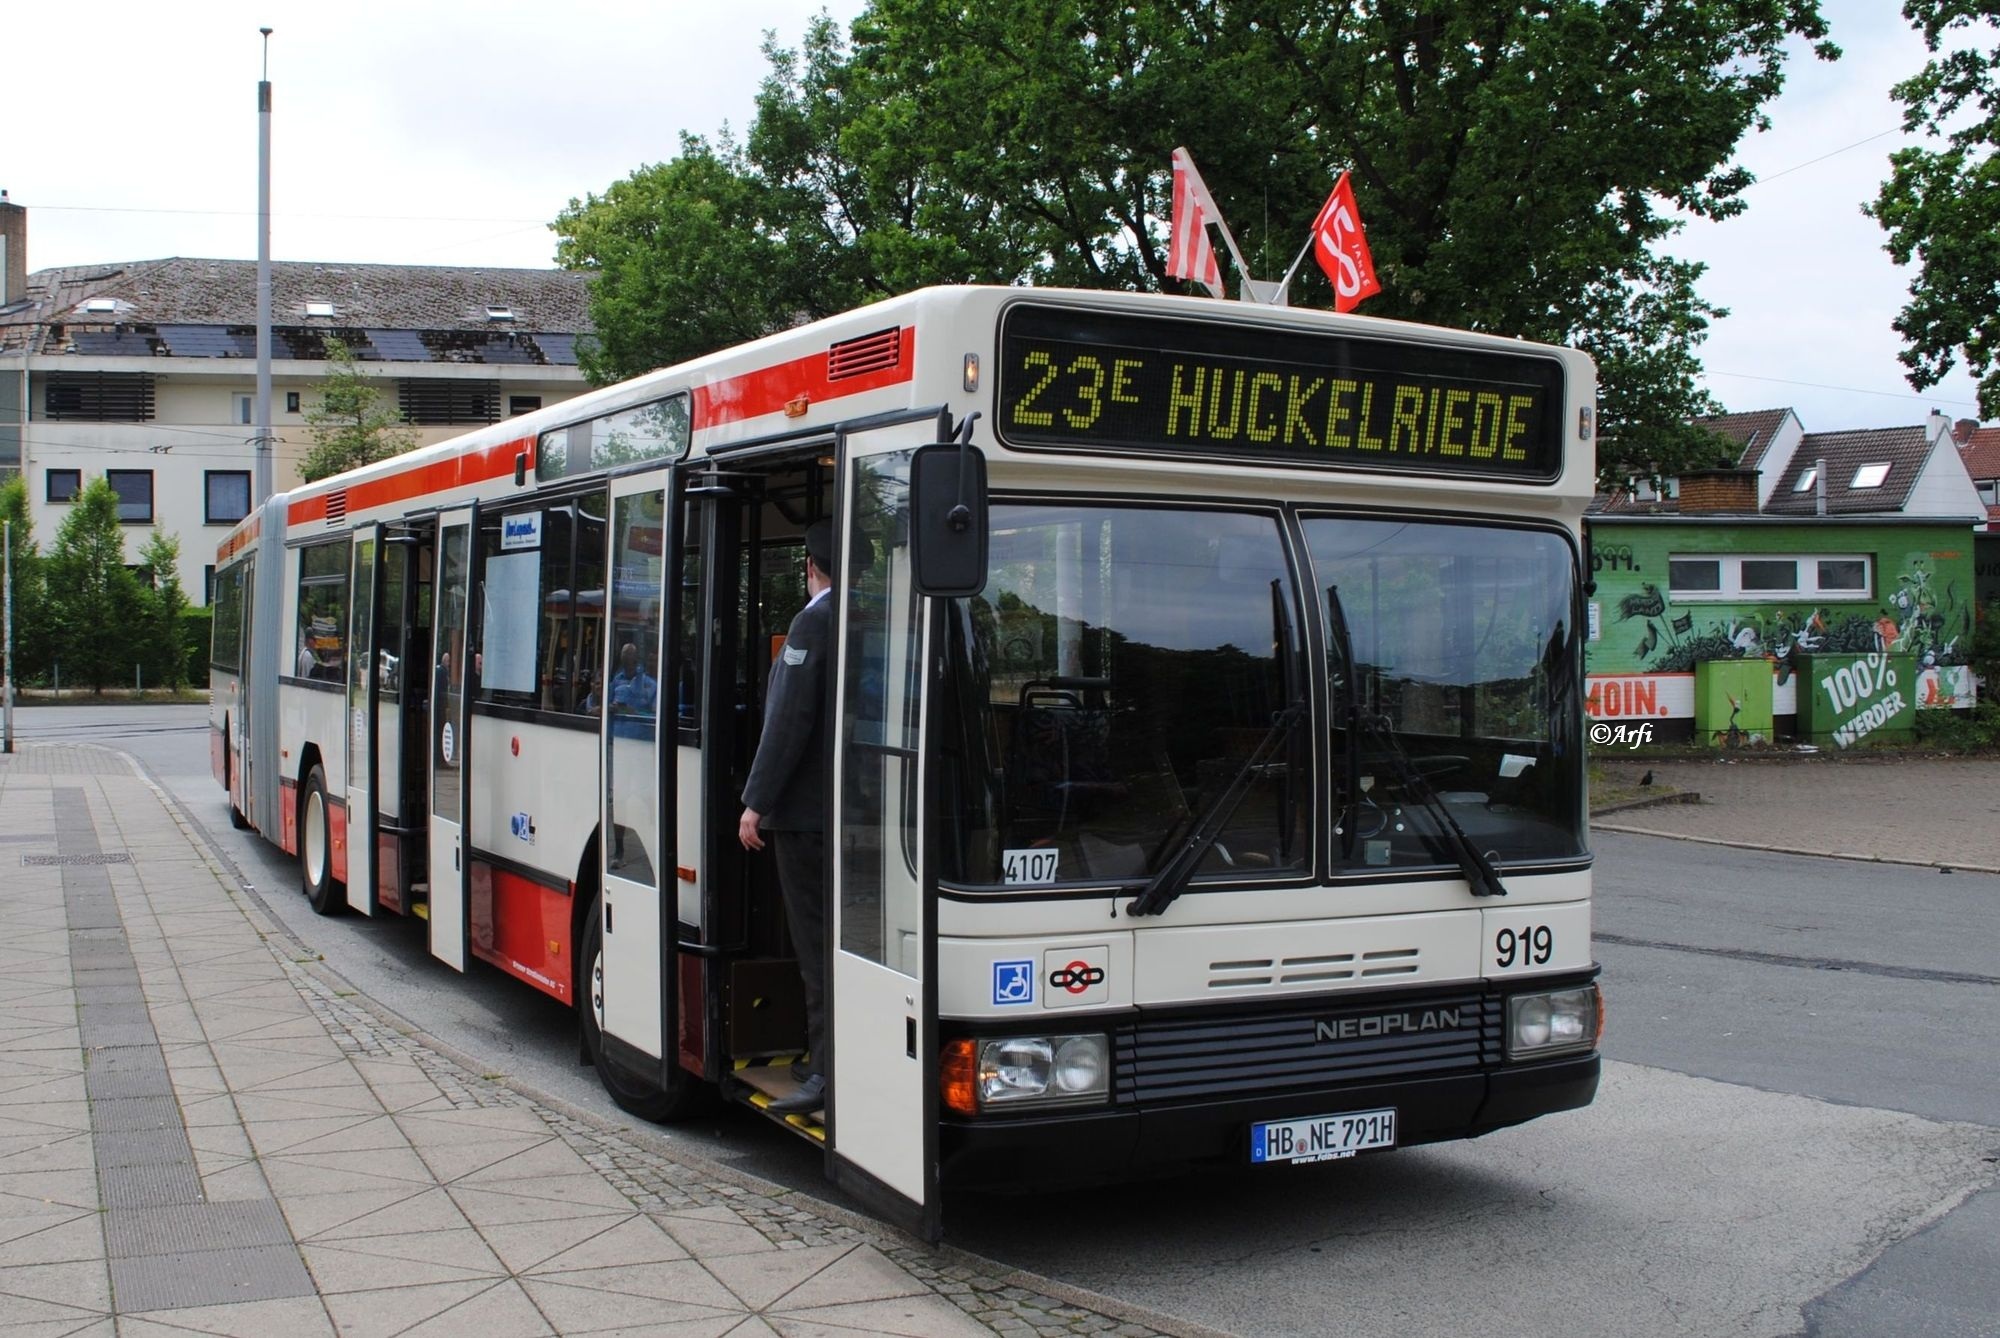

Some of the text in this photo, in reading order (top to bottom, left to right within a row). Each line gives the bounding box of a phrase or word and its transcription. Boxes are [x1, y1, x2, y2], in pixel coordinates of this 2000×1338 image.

[1167, 364, 1533, 461] HUCKELRIEDE
[1821, 652, 1897, 715] 100%
[1832, 691, 1907, 750] WERDER
[1005, 854, 1057, 882] 4107
[1496, 925, 1553, 968] 919
[1316, 1008, 1460, 1042] NEOPLAN
[1267, 1114, 1393, 1156] HB NE 791H
